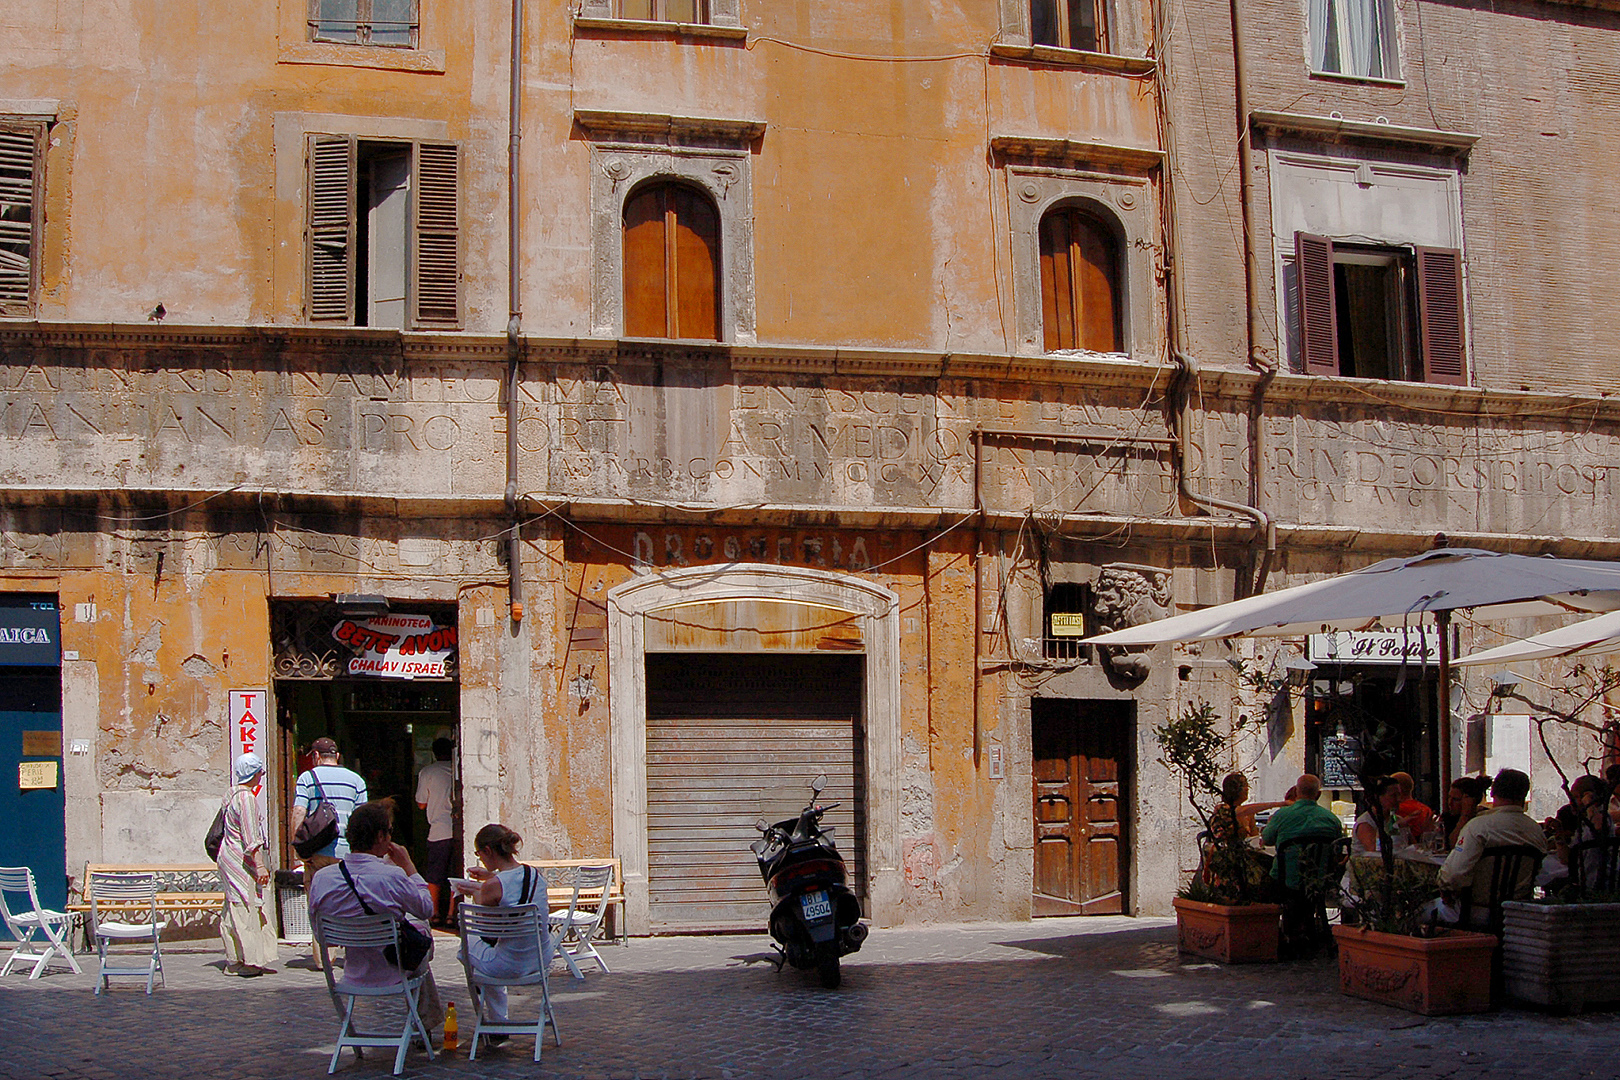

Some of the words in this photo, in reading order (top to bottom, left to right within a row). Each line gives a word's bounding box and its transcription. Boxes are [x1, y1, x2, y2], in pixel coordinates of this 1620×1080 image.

[359, 412, 462, 451] PRO
[368, 617, 431, 628] PANINOTECA
[0, 628, 50, 643] AICA
[399, 627, 457, 655] AVON
[350, 658, 399, 672] CHALAV
[400, 661, 445, 675] ISRAEL
[805, 903, 830, 918] 49504
